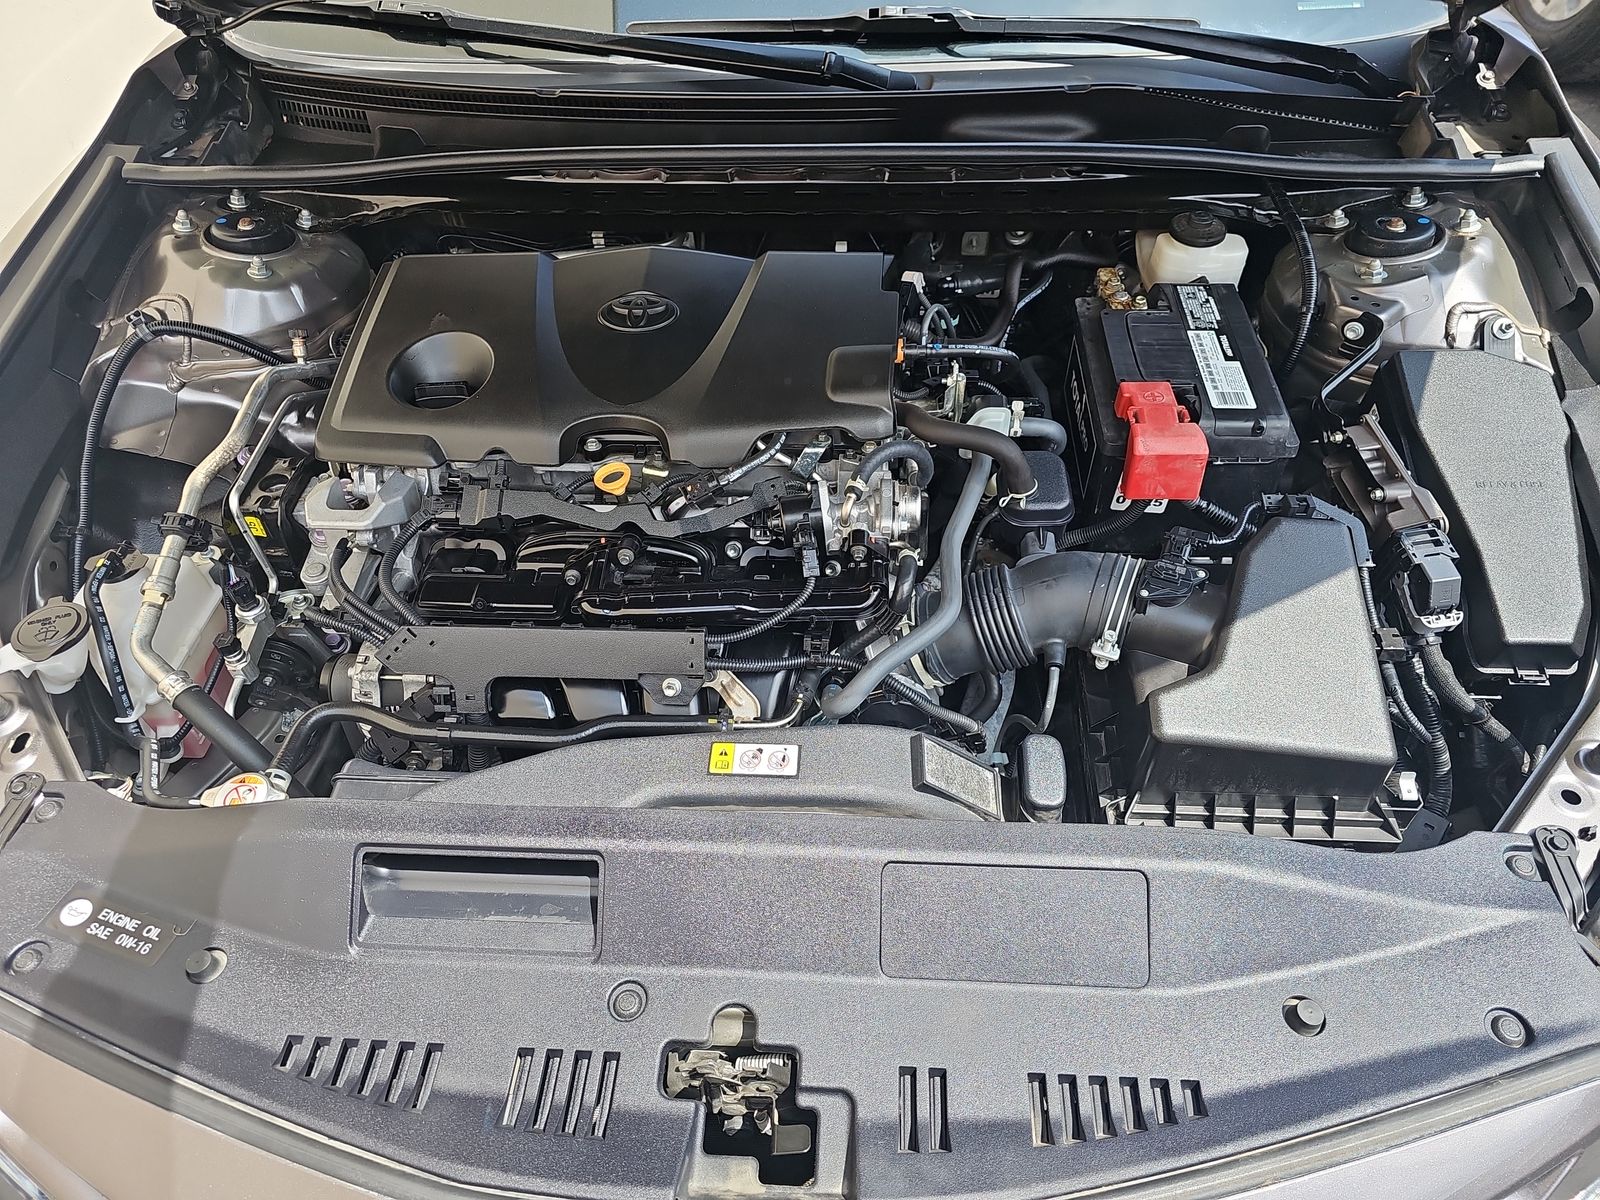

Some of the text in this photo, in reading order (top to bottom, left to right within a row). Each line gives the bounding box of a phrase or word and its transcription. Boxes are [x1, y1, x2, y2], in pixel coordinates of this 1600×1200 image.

[86, 922, 153, 955] SAE 0W-16
[97, 908, 163, 941] ENGINE OIL
